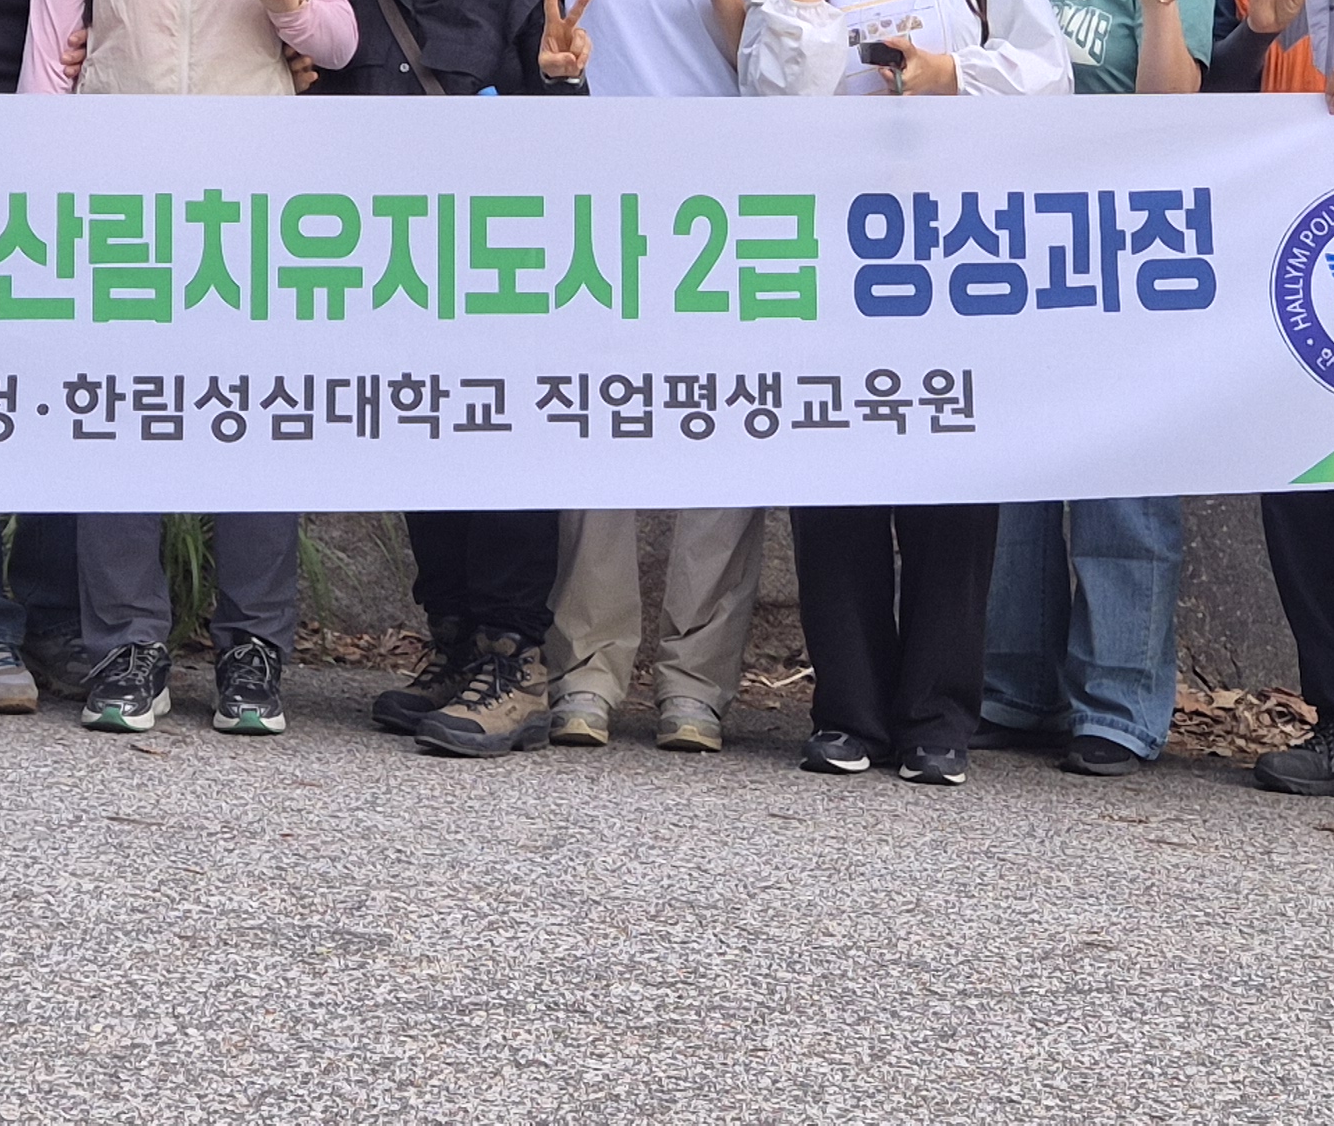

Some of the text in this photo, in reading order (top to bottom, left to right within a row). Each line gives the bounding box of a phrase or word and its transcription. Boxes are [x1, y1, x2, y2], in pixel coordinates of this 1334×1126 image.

[672, 193, 819, 321] 2급
[847, 187, 1217, 317] 양성과정
[1283, 247, 1312, 332] HALLYM
[535, 368, 976, 441] 직업평생교육원
